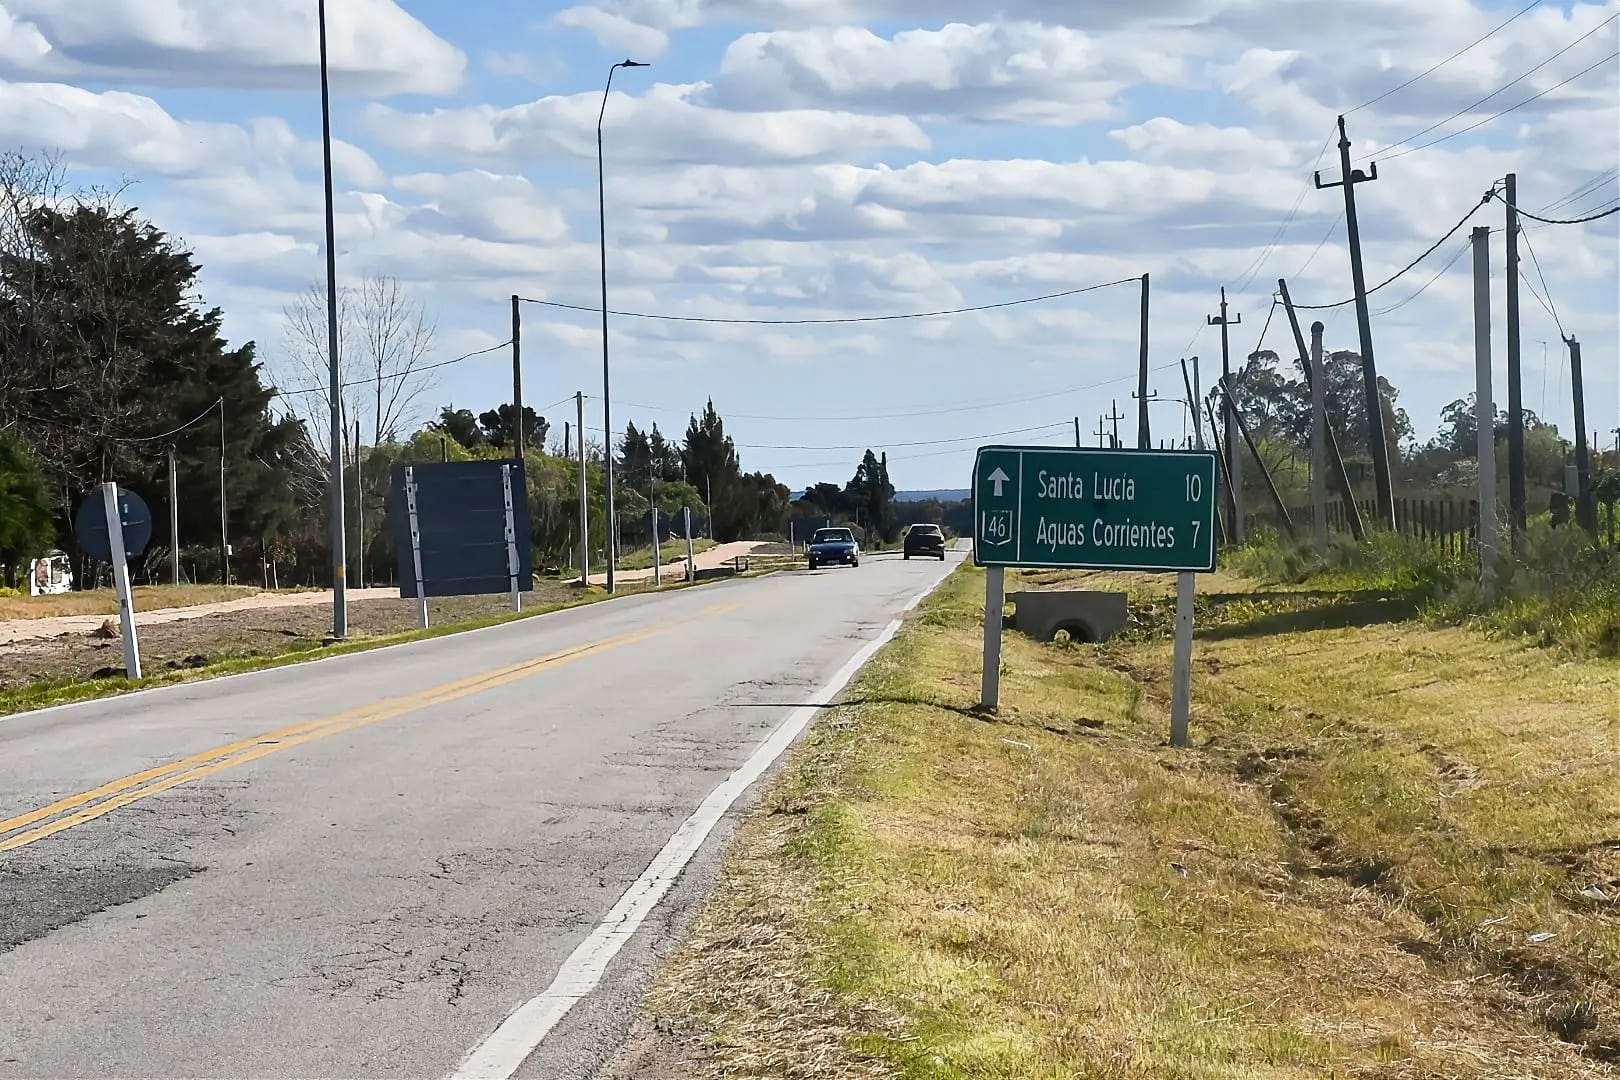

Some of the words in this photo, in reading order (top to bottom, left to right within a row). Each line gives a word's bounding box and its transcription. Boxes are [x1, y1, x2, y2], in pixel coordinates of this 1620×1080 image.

[1037, 470, 1083, 499] Santa
[1093, 471, 1136, 501] Lucía
[1185, 474, 1202, 502] 10
[988, 515, 1006, 538] 46
[1036, 516, 1085, 552] Aguas
[1092, 517, 1175, 548] Corrientes
[1191, 520, 1201, 549] 7
